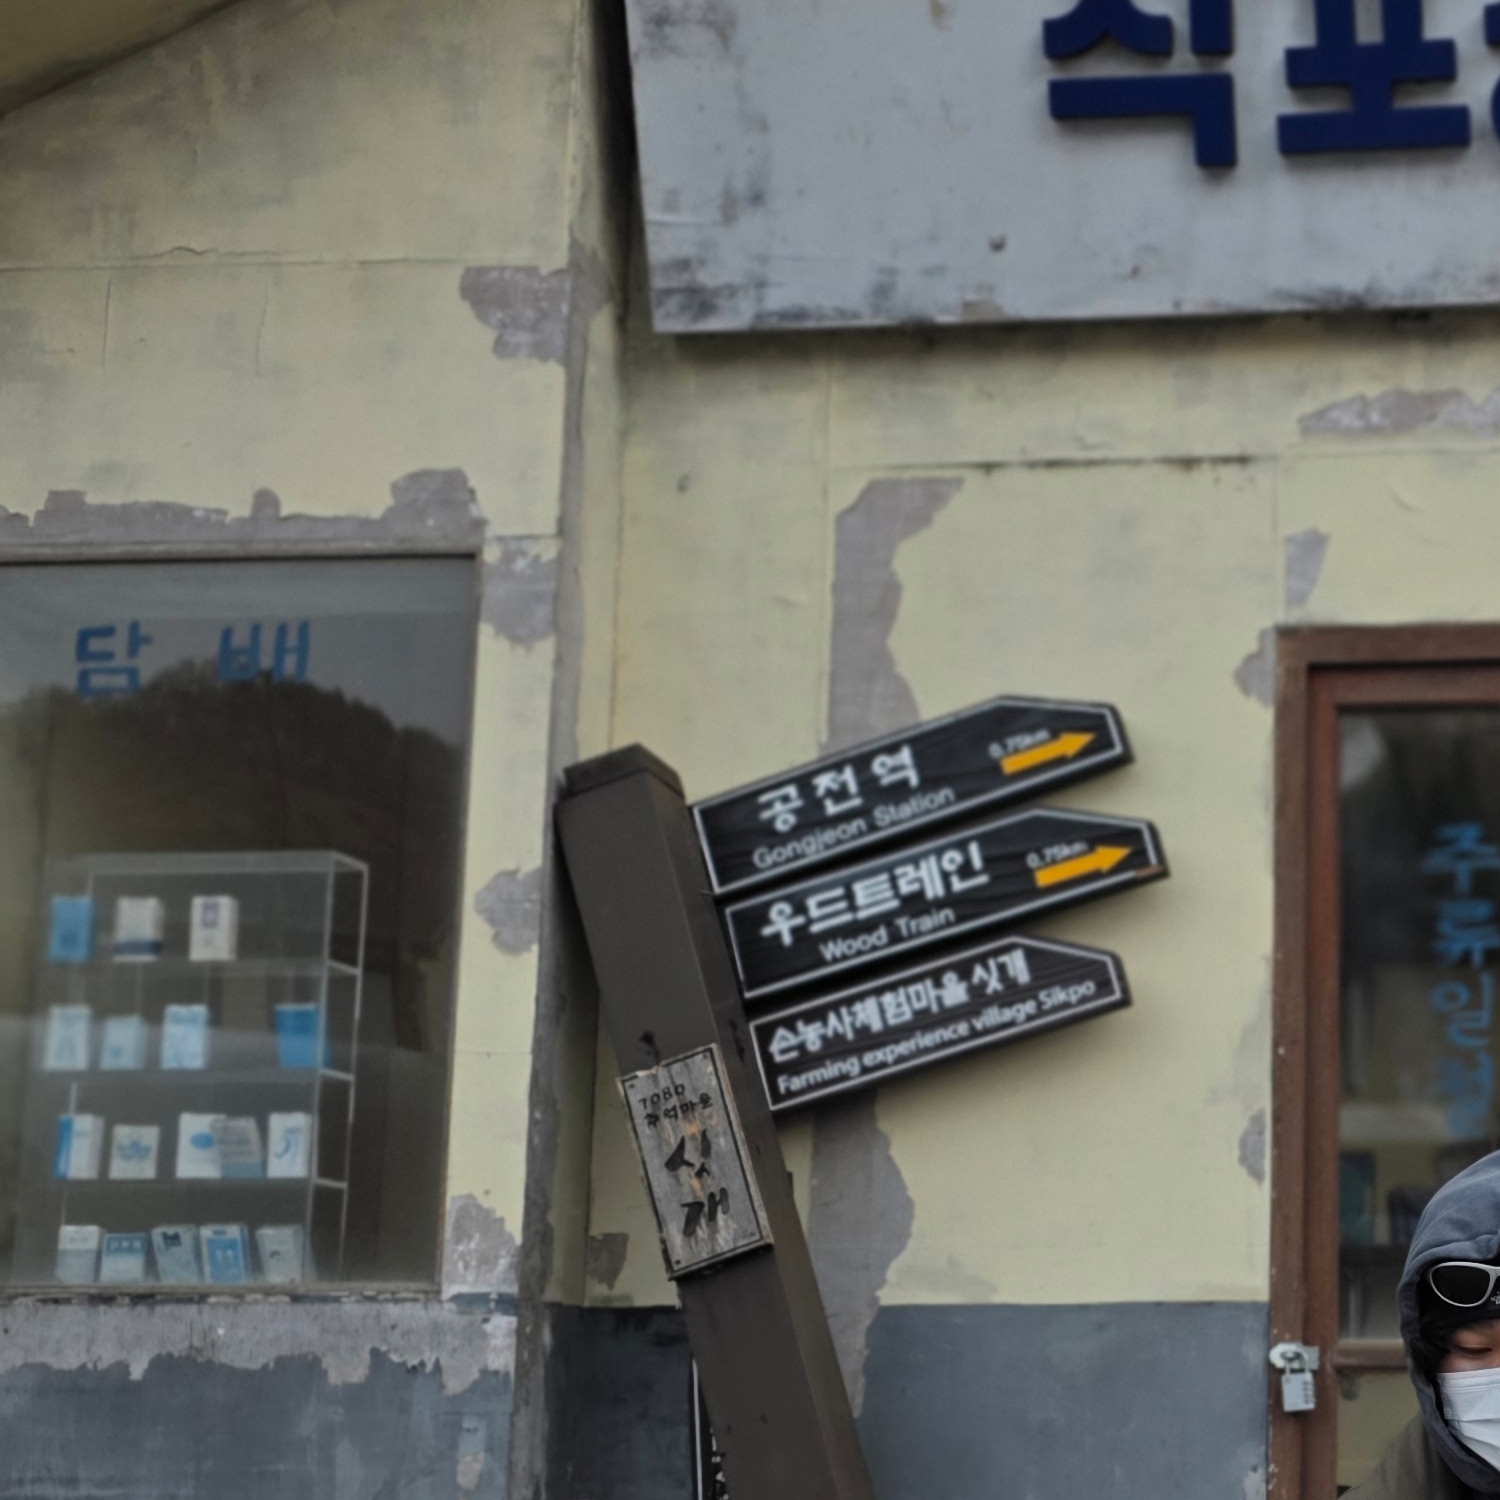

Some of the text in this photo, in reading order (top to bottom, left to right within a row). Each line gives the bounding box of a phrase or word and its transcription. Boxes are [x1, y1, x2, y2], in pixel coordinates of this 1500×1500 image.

[75, 619, 311, 698] 담배
[753, 786, 955, 870] Gongjeon Station
[757, 745, 920, 833] 공전역
[760, 841, 990, 947] 우드트레인
[819, 907, 956, 962] Wood Train
[777, 980, 1096, 1095] Farming experience village Sikpo
[638, 1083, 686, 1111] 7080
